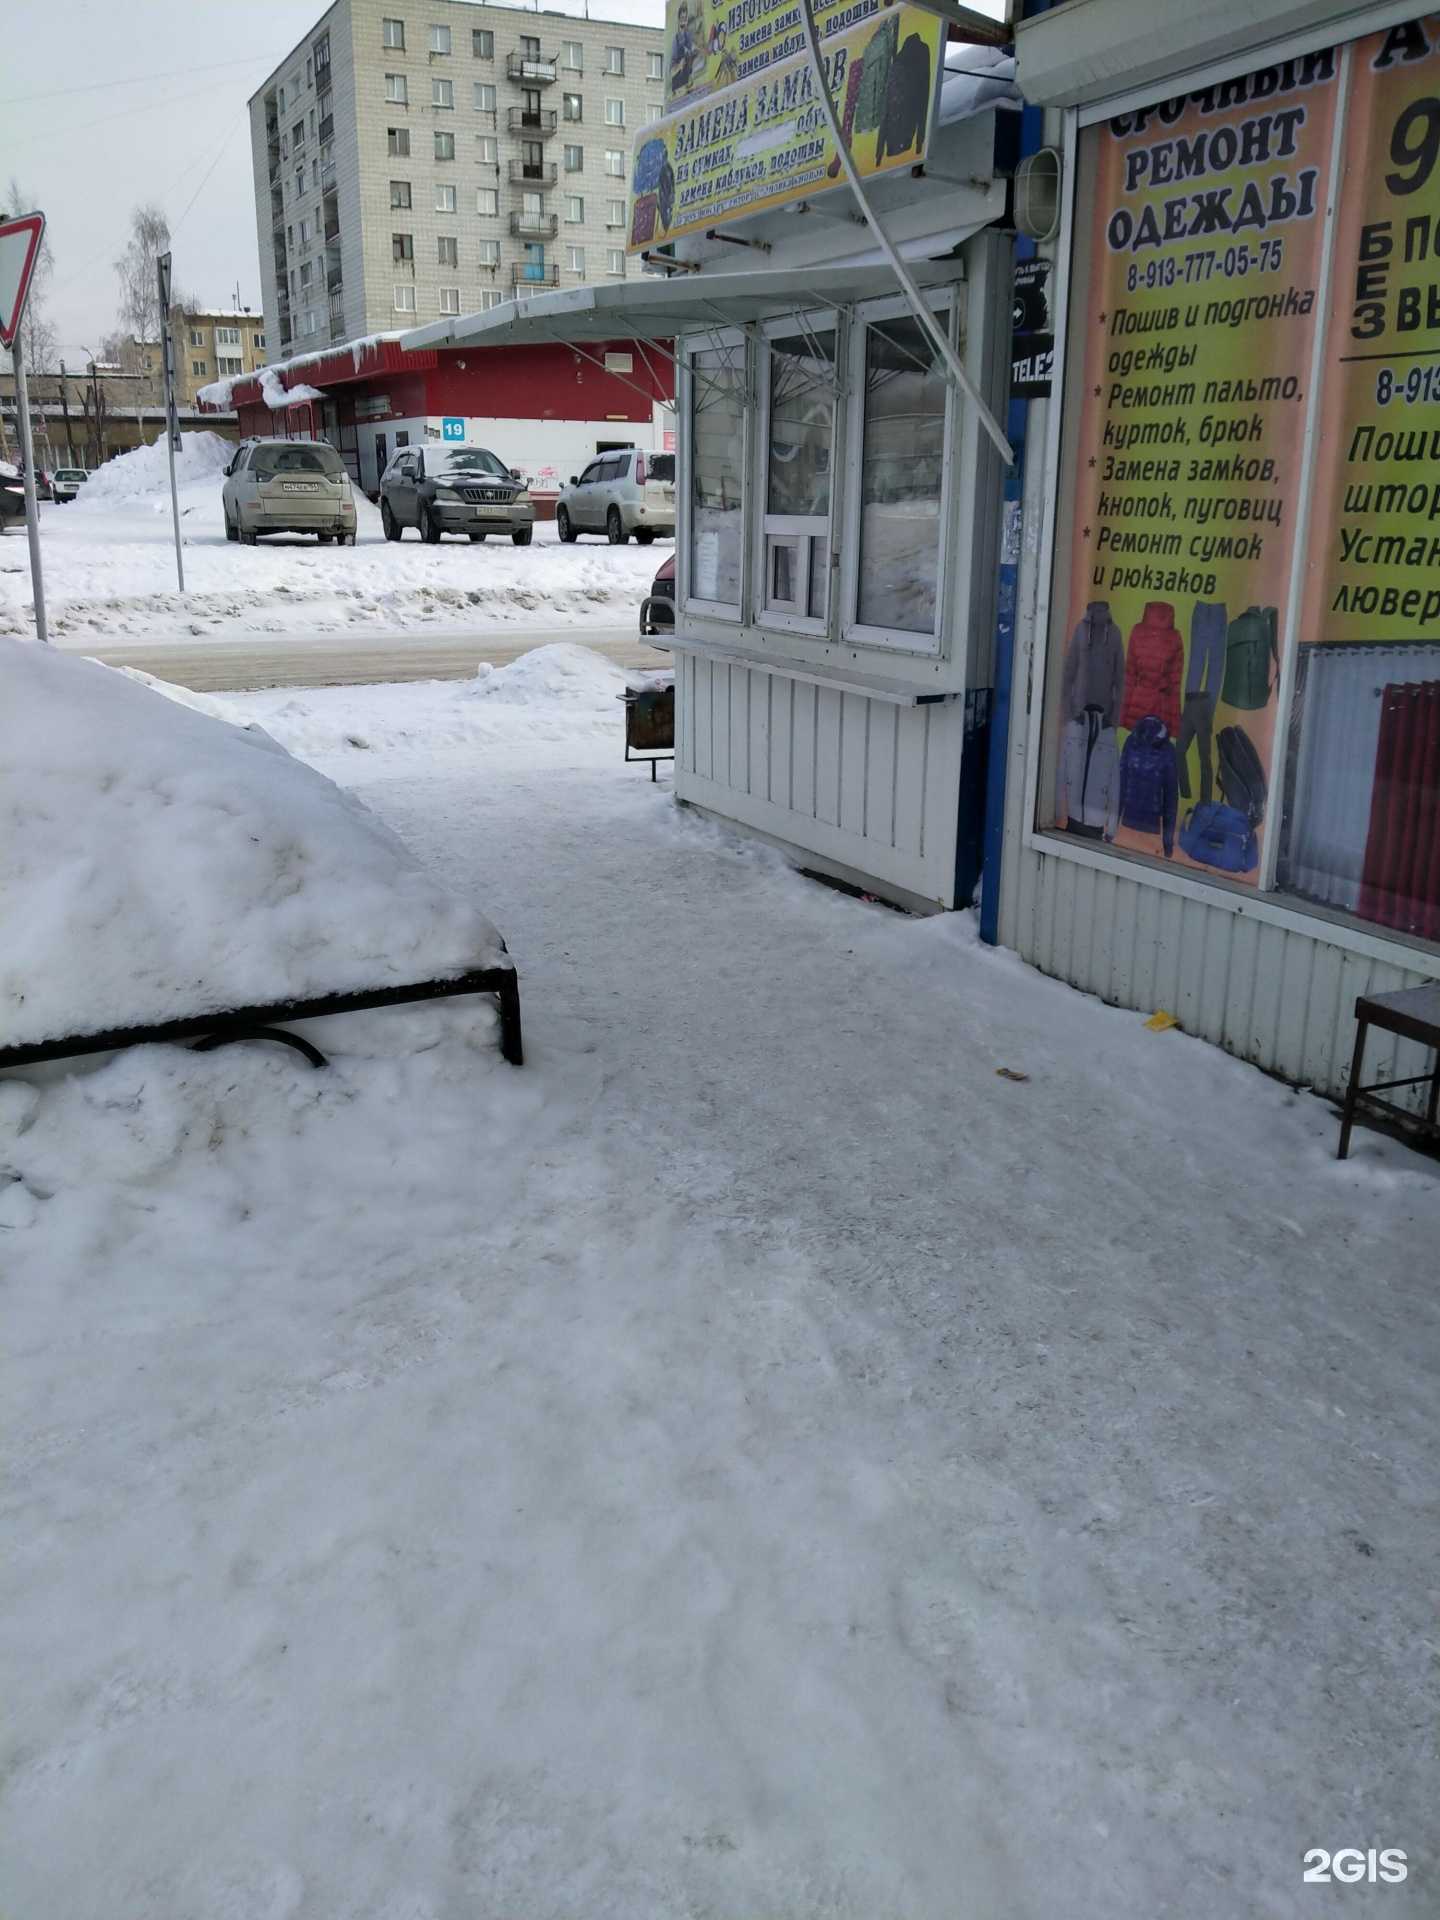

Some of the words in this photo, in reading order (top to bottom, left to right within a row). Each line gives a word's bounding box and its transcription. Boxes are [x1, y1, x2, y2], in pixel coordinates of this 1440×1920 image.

[826, 0, 879, 33] подошвы
[675, 94, 749, 160] ЗАМЕНА
[1125, 107, 1305, 192] РЕМОНТ
[1108, 170, 1319, 252] ОДЕЖДЫ
[1127, 239, 1284, 292] 8-913-777-05-75
[1110, 304, 1179, 337] Пошив
[1184, 304, 1200, 327] и
[1203, 287, 1315, 330] подгонка
[1108, 343, 1198, 375] одежды
[1107, 382, 1197, 411] Ремонт
[1202, 375, 1304, 404] пальто,
[445, 423, 463, 436] 19
[1102, 418, 1191, 450] курток,
[1199, 413, 1264, 447] брюк
[1102, 456, 1179, 482] Замена
[1187, 453, 1280, 484] замков,
[1096, 491, 1176, 521] кнопок,
[1183, 495, 1284, 527] пуговиц
[1096, 525, 1182, 556] Ремонт
[1189, 532, 1263, 562] сумок
[1093, 566, 1105, 585] и
[1110, 565, 1218, 596] рюкзаков
